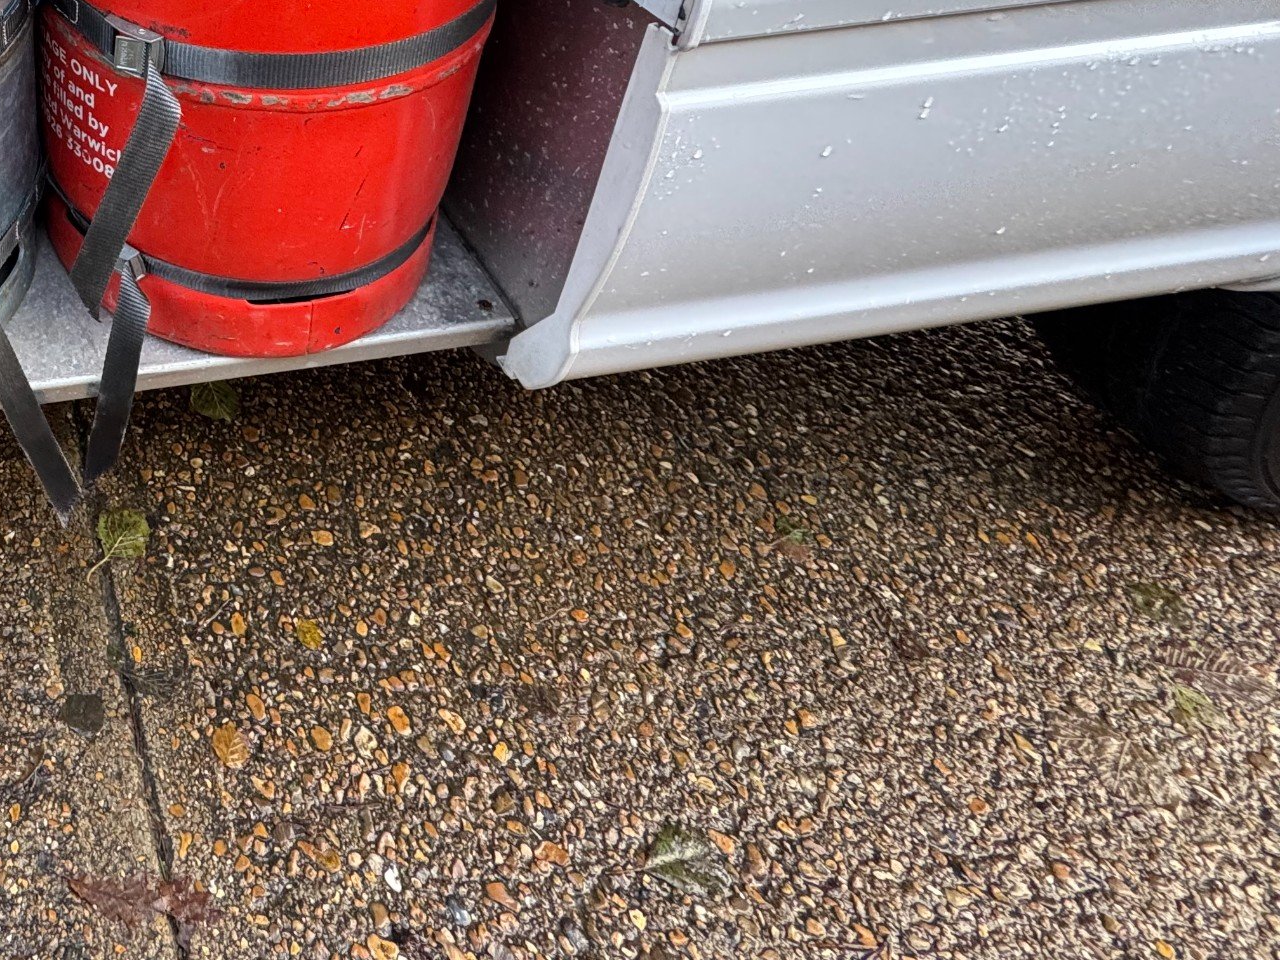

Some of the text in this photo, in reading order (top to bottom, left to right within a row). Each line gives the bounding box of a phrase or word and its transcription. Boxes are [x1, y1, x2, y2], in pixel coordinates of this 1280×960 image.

[54, 65, 65, 83] of
[68, 80, 95, 109] and
[71, 58, 118, 97] ONLY
[54, 82, 83, 120] filled
[88, 112, 109, 137] by
